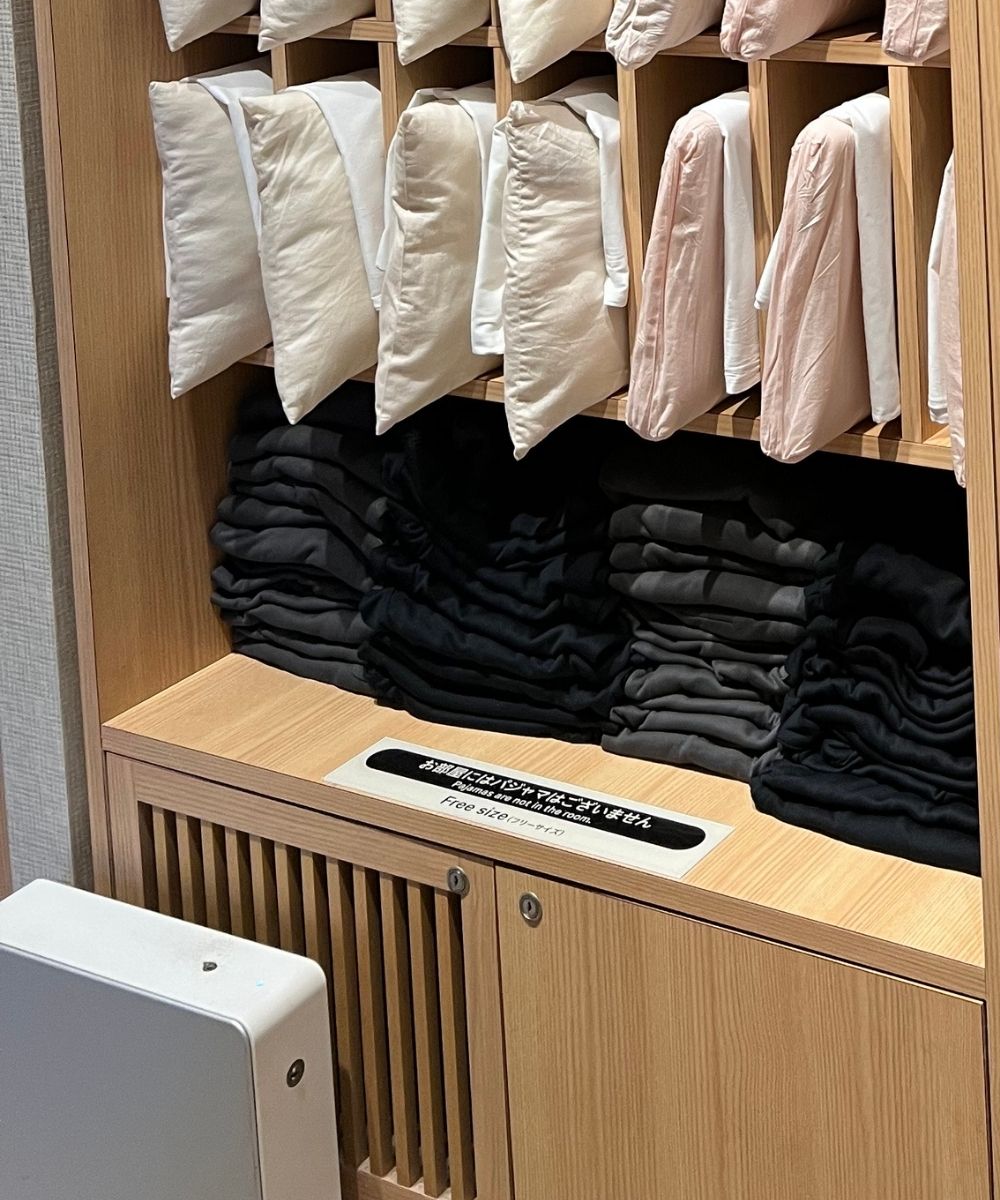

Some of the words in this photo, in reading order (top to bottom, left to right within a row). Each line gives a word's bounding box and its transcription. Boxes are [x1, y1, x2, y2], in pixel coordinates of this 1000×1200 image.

[419, 760, 652, 829] お部屋にはパジャマはございません
[440, 796, 475, 811] Free
[476, 807, 509, 821] size
[451, 780, 494, 797] Pajamas
[494, 793, 512, 802] are
[512, 798, 532, 807] not
[531, 801, 543, 810] in
[543, 805, 562, 815] the
[562, 811, 591, 824] room.
